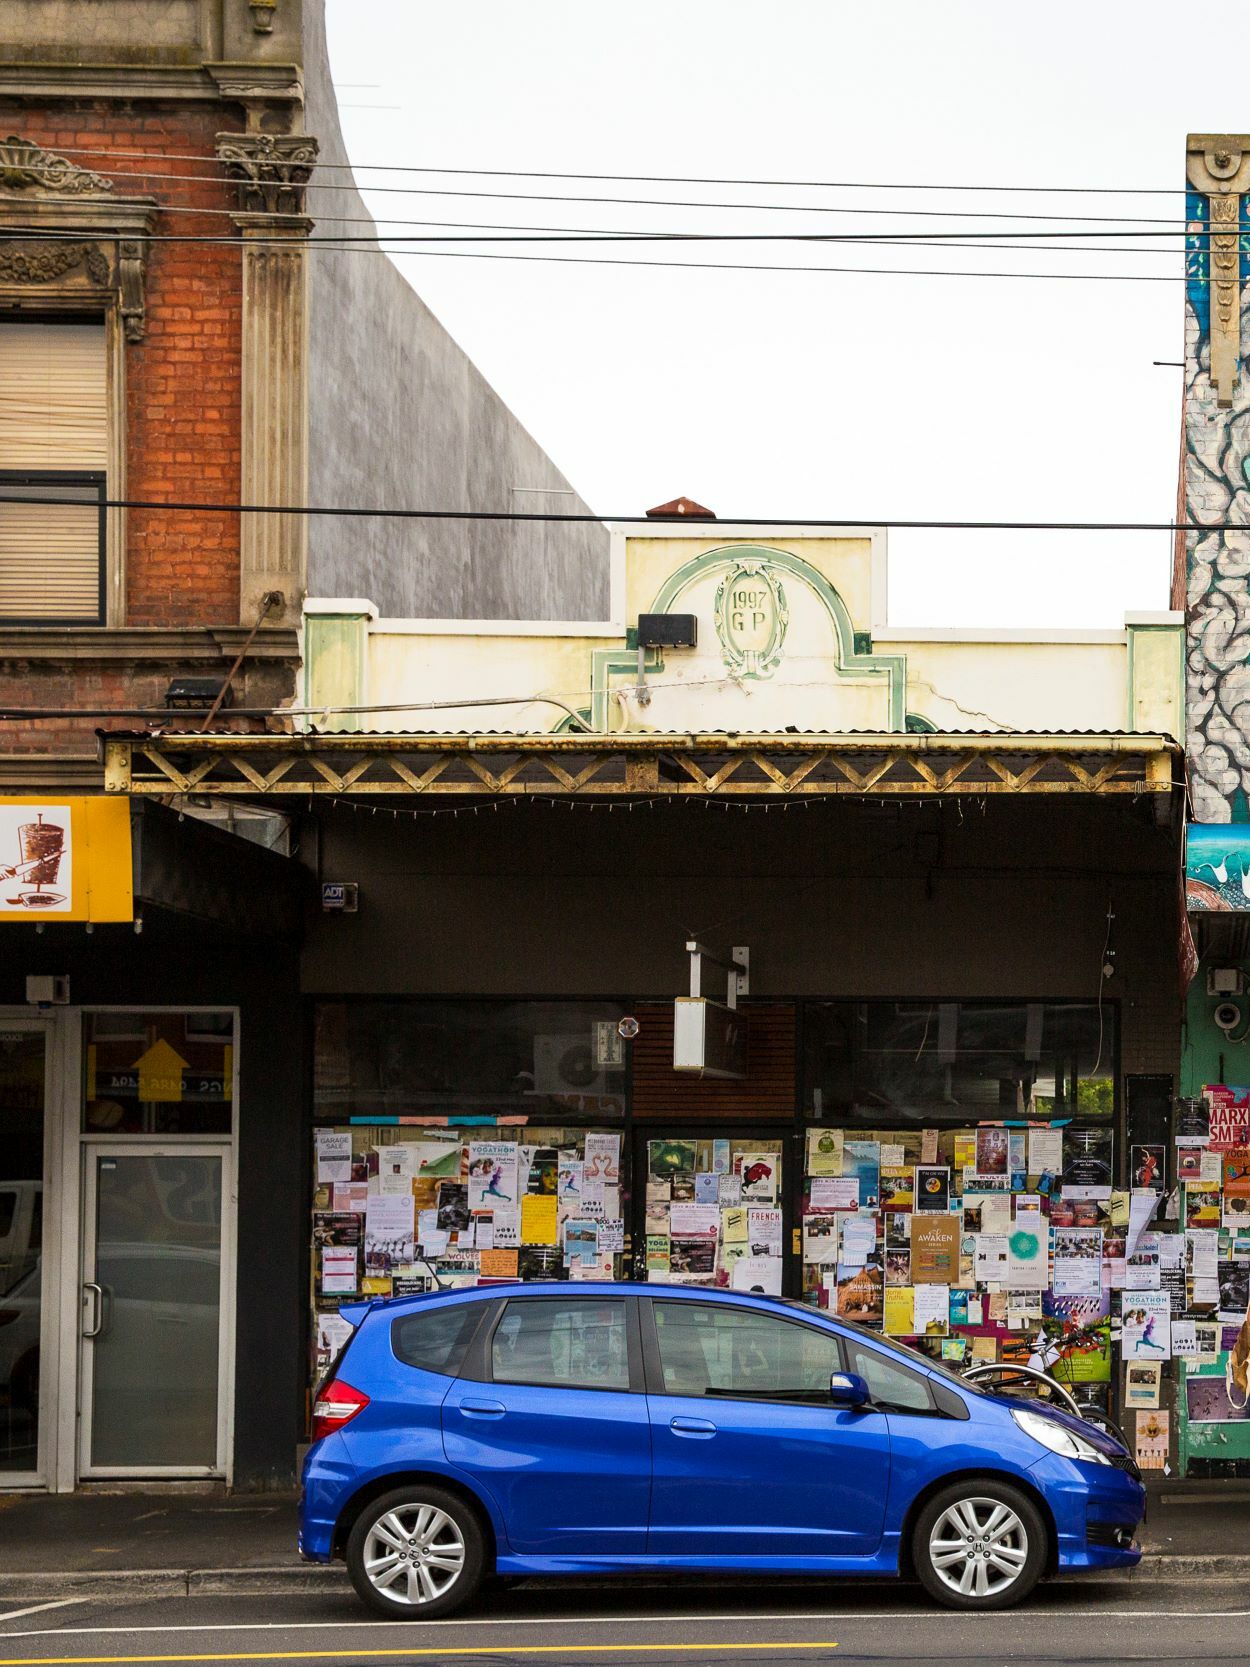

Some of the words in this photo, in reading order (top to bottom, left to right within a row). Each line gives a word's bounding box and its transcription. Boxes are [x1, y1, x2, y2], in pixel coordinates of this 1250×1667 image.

[732, 590, 767, 610] 1997
[324, 887, 344, 898] ADT
[1225, 1150, 1249, 1158] YOGA
[751, 1212, 780, 1221] FRENCH
[918, 1234, 953, 1242] AWAKEN
[448, 1253, 480, 1261] WOLVES
